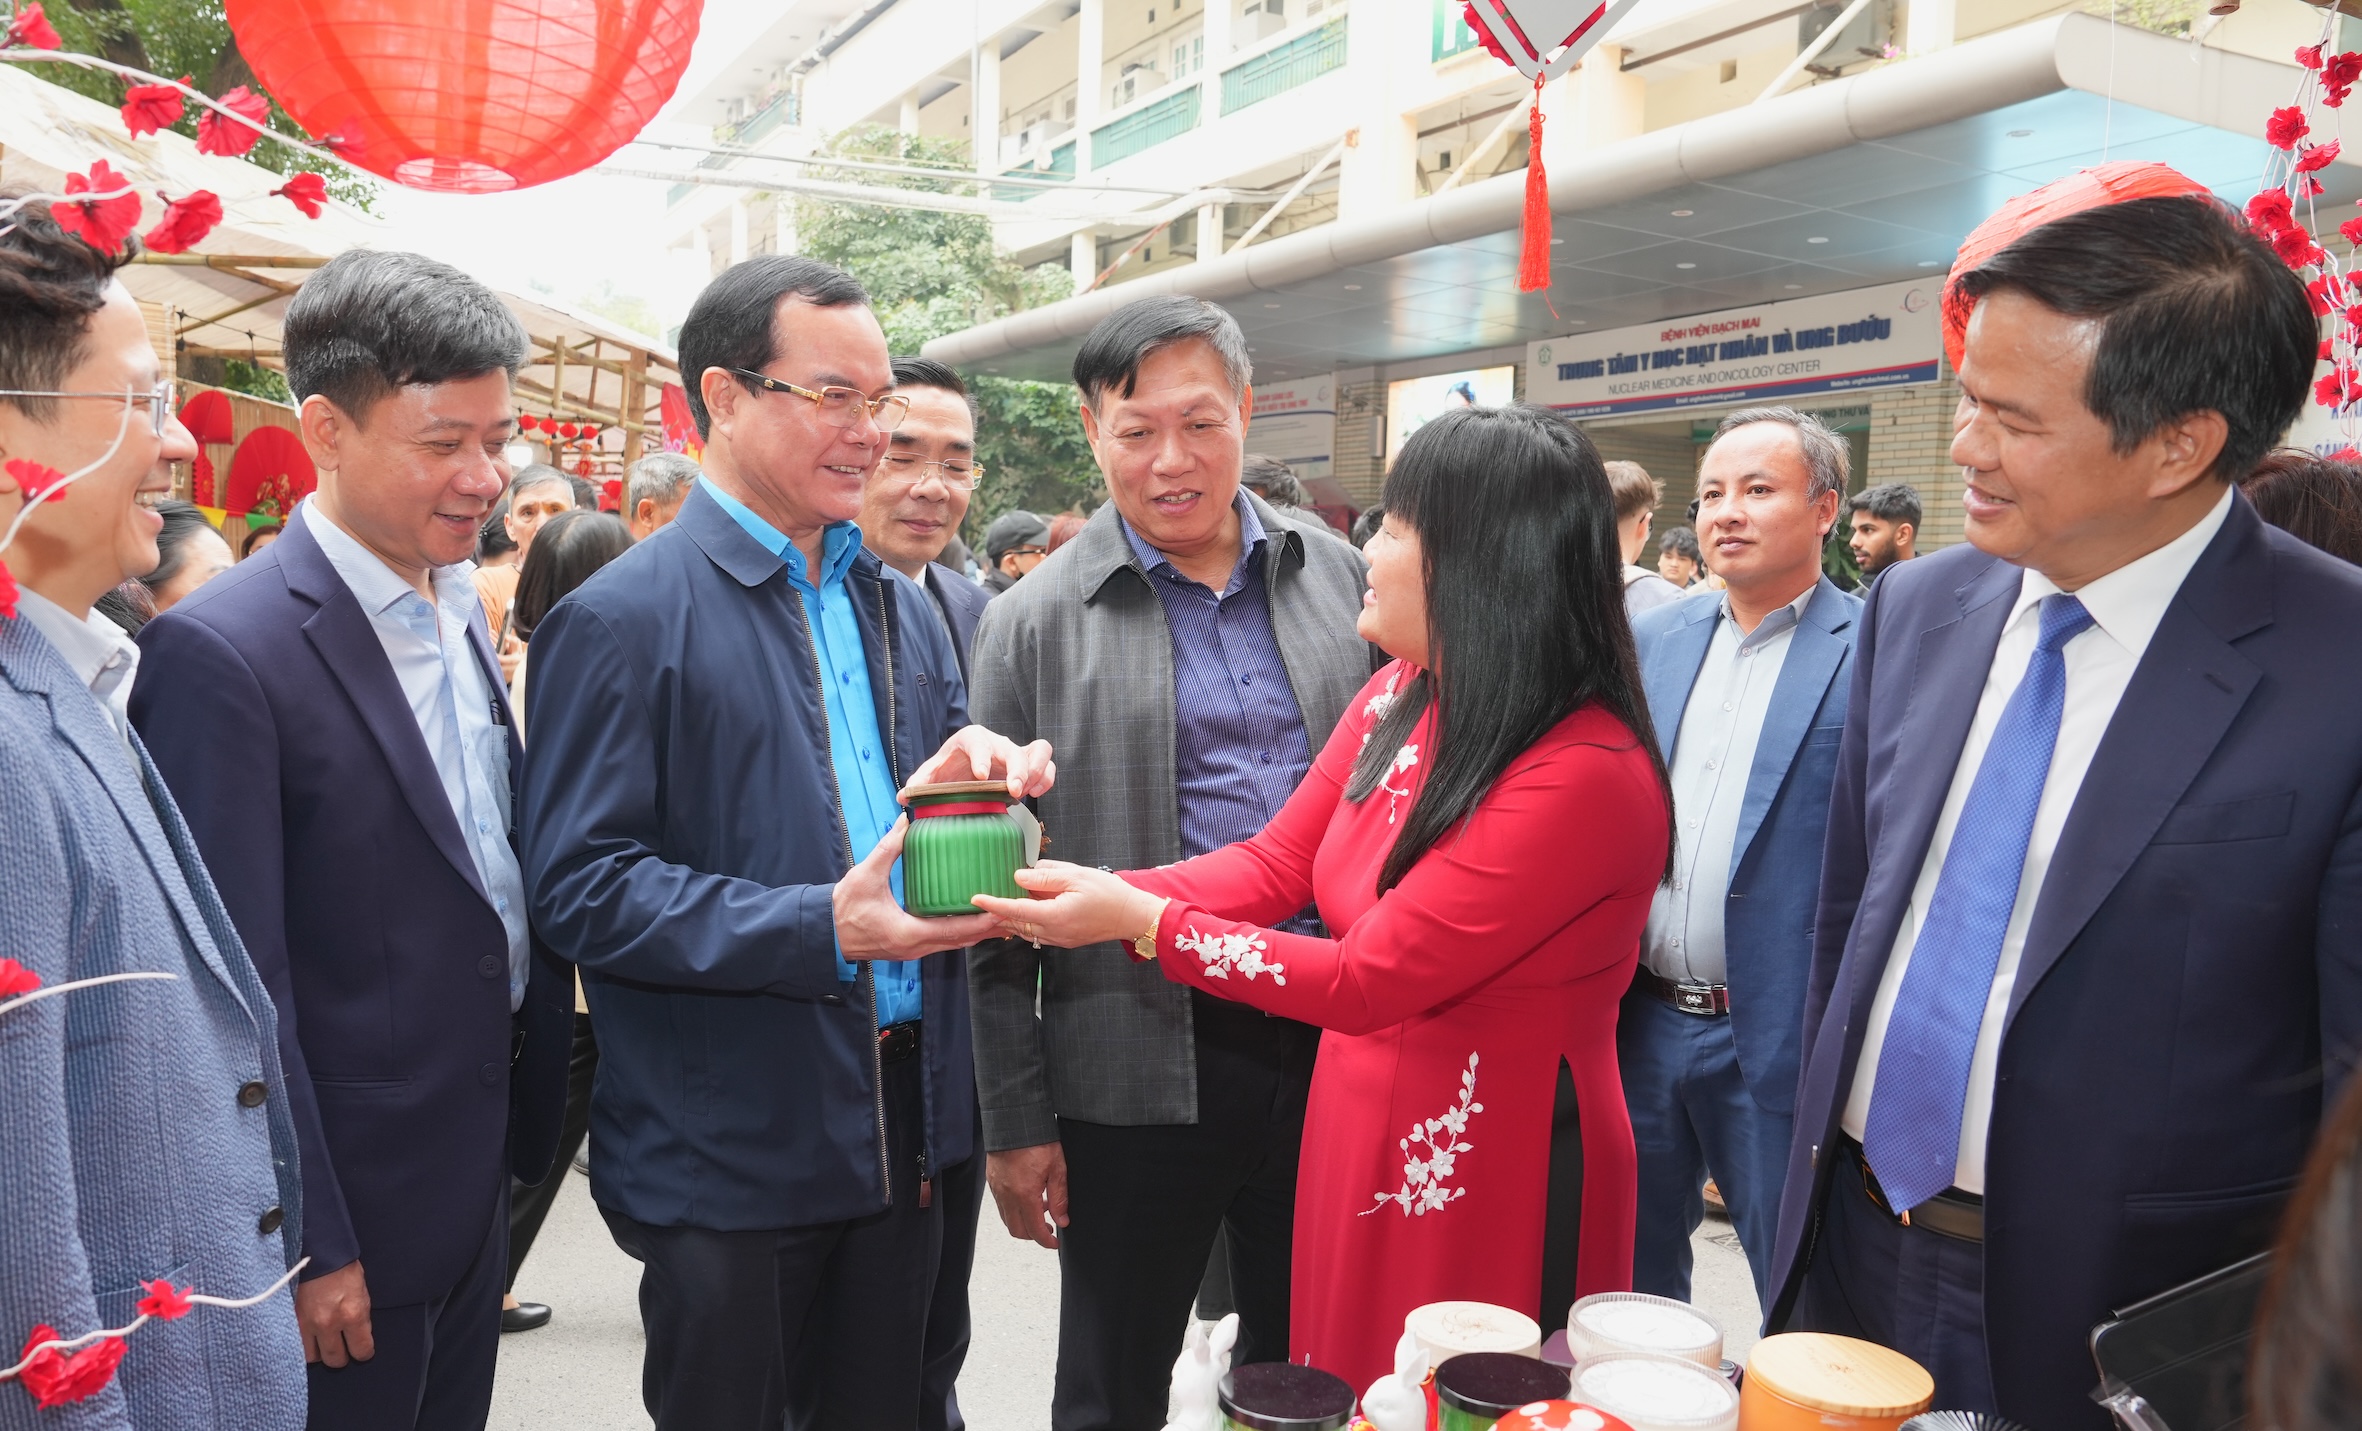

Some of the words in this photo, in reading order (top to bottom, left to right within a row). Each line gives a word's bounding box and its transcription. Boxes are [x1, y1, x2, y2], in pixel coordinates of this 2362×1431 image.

[1557, 359, 1605, 381] TRUNG
[1607, 352, 1639, 376] TÂM
[1640, 352, 1650, 371] Y
[1652, 348, 1685, 371] HỌC
[1686, 343, 1718, 367] HẠT
[1719, 334, 1769, 361] NHÂN
[1771, 328, 1794, 353] VÀ
[1796, 327, 1835, 351] UNG
[1837, 314, 1891, 345] BƯỚU
[1661, 328, 1687, 342] BỆNH
[1689, 323, 1711, 338] VIỆN
[1712, 320, 1739, 335] BẠCH
[1742, 317, 1761, 329] MAI
[1608, 381, 1651, 395] NUCLEAR
[1652, 375, 1695, 390] MEDICINE
[1696, 371, 1717, 386] AND
[1717, 365, 1775, 383] ONCOLOGY
[1777, 359, 1821, 376] CENTER
